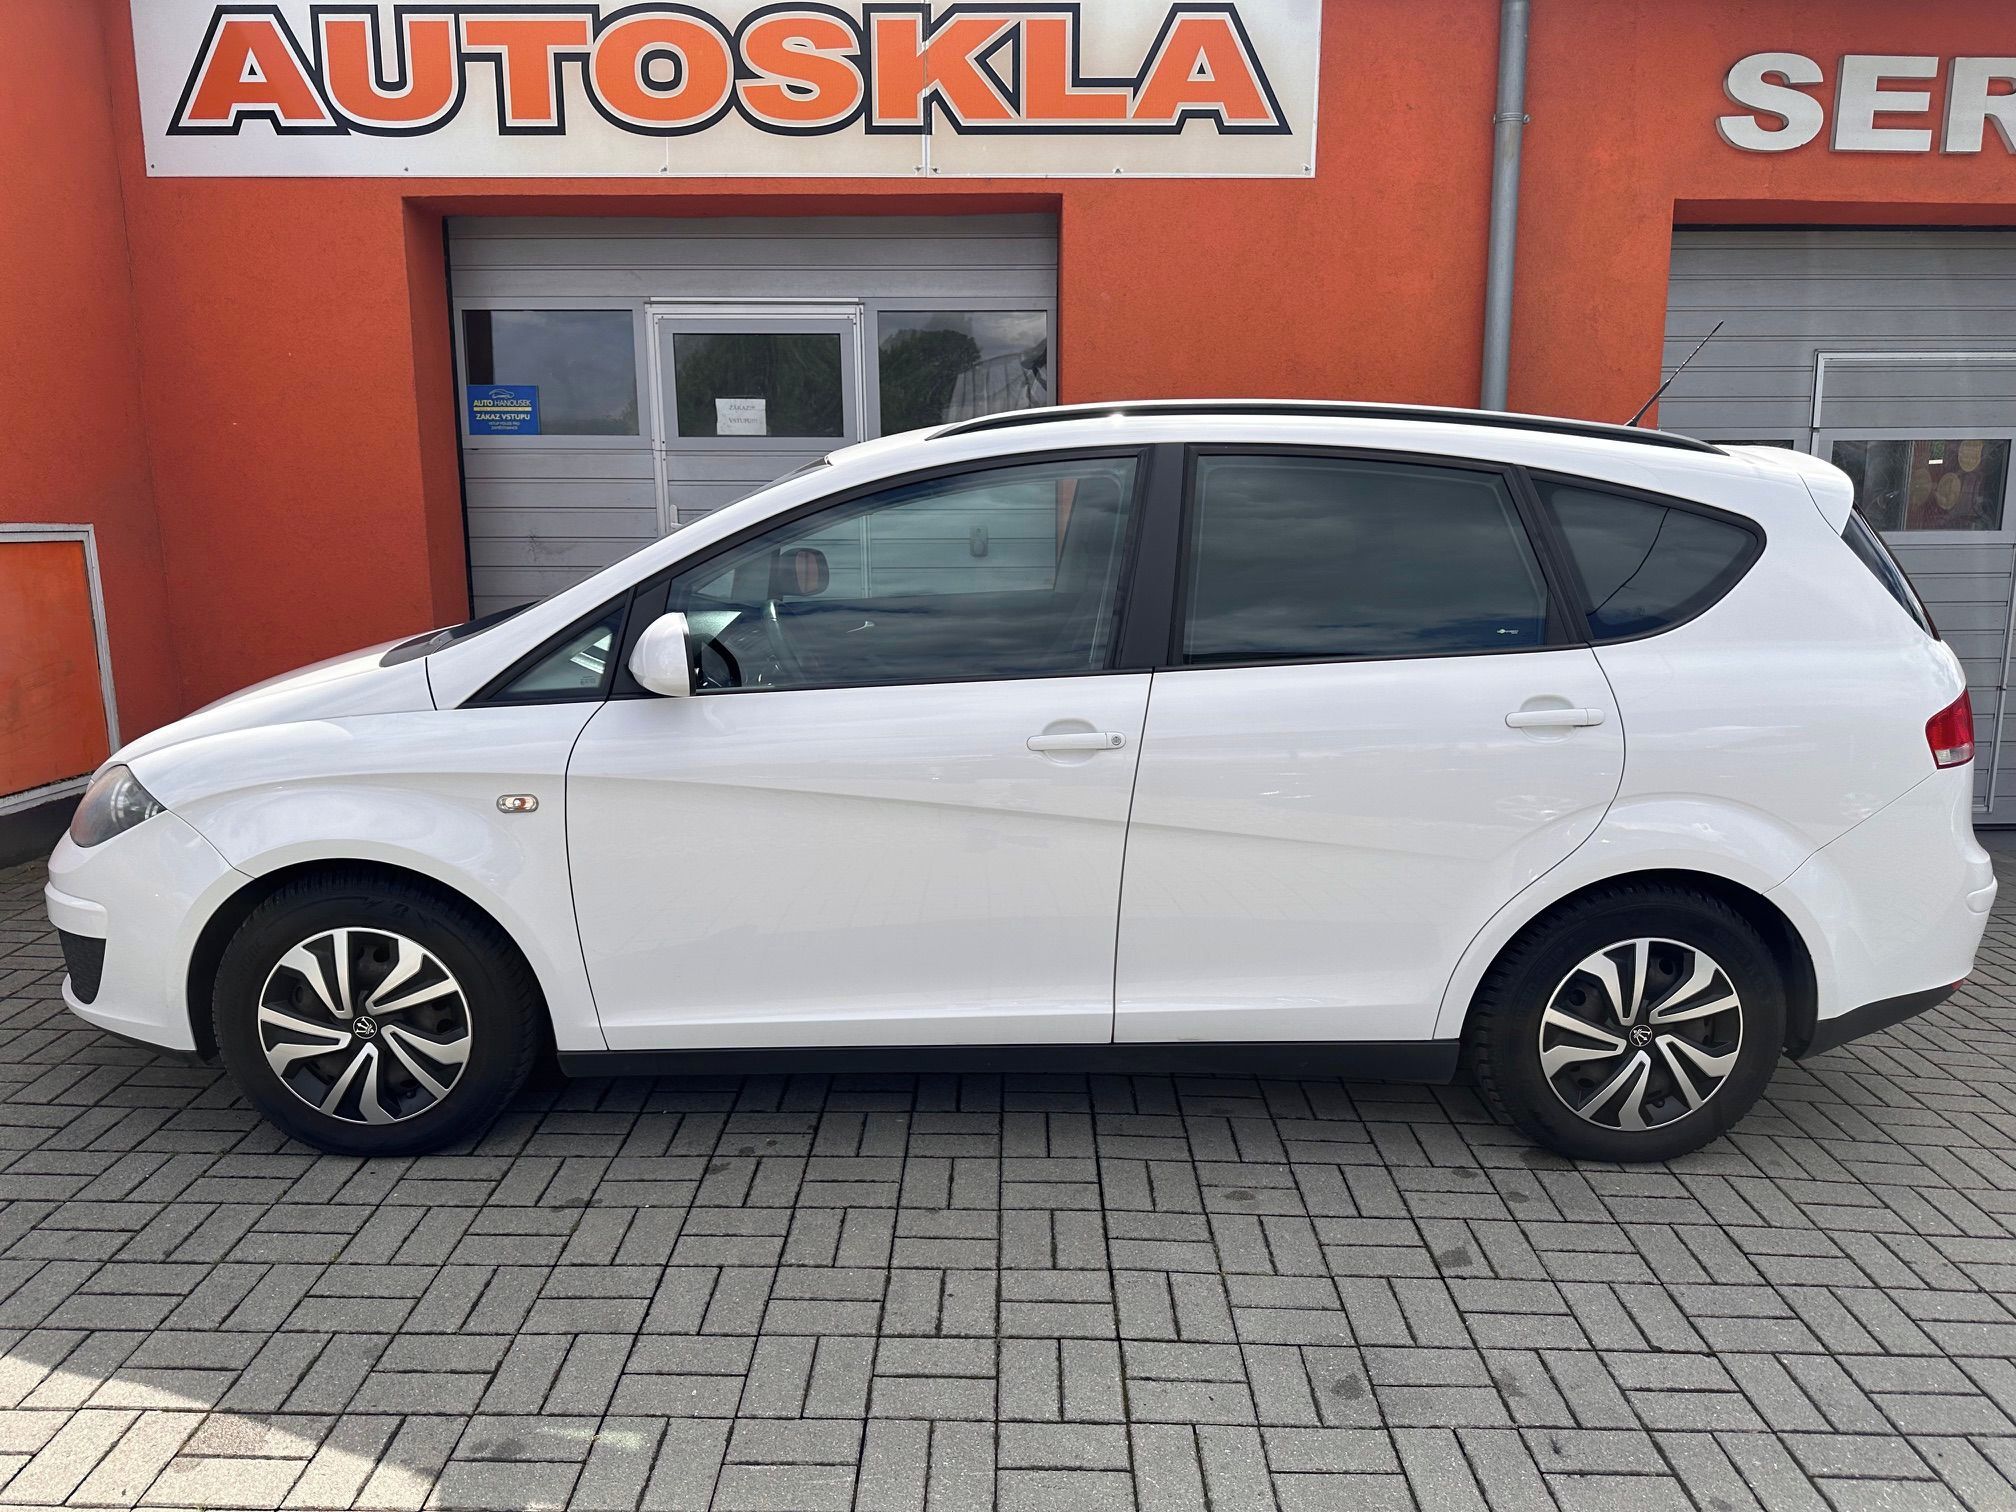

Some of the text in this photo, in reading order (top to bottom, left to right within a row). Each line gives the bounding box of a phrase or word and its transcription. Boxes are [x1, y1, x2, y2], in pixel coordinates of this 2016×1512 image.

[166, 2, 1293, 137] AUTOSKLA
[1716, 52, 2016, 154] SER
[476, 412, 501, 420] ZÁKAZ
